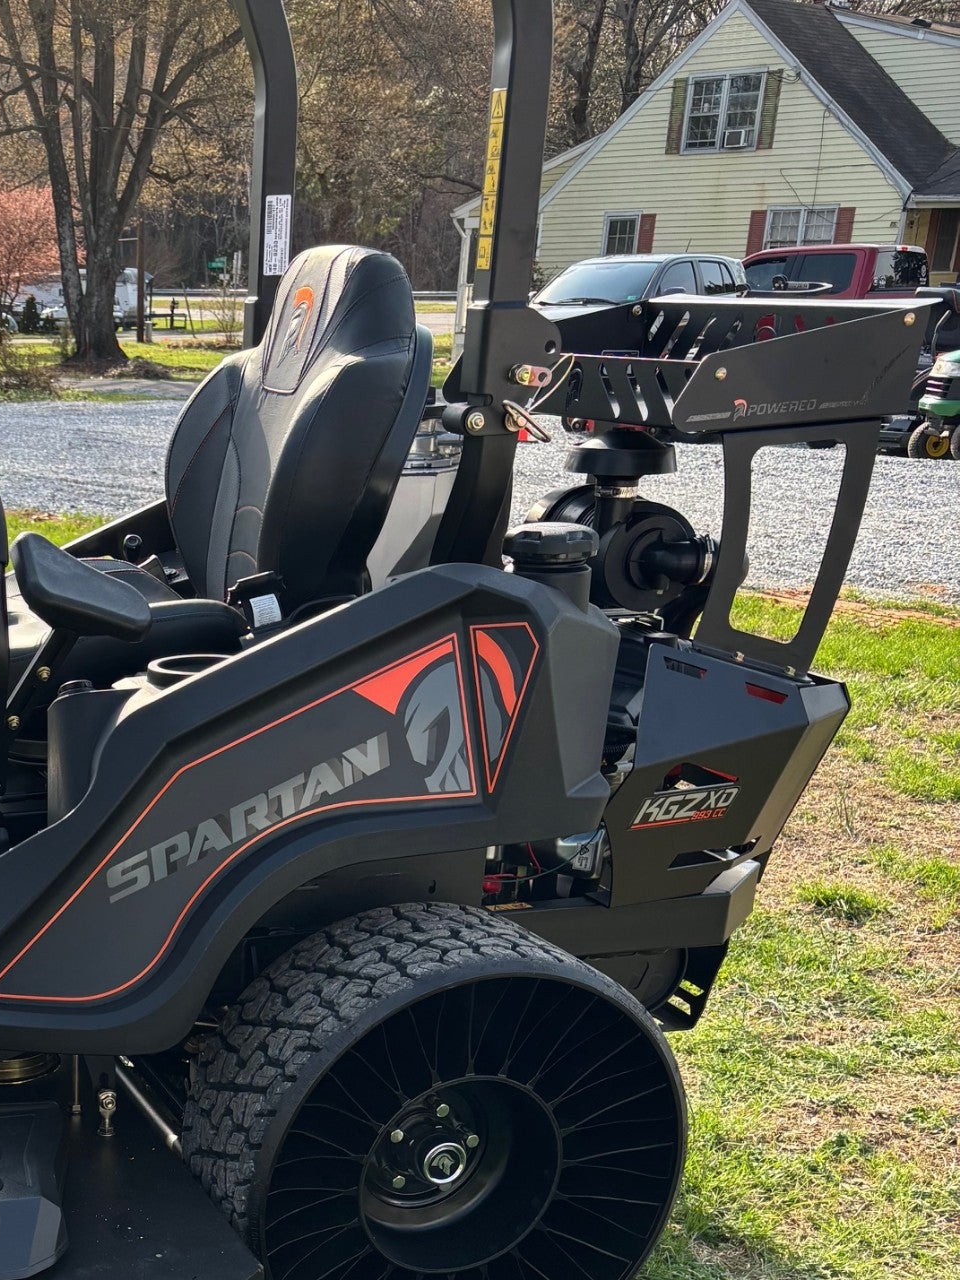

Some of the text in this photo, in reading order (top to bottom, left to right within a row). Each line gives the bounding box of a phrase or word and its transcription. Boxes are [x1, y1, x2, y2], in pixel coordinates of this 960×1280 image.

[747, 399, 817, 416] POWERED
[106, 731, 390, 904] SPARTAN
[690, 808, 726, 820] 993 CC
